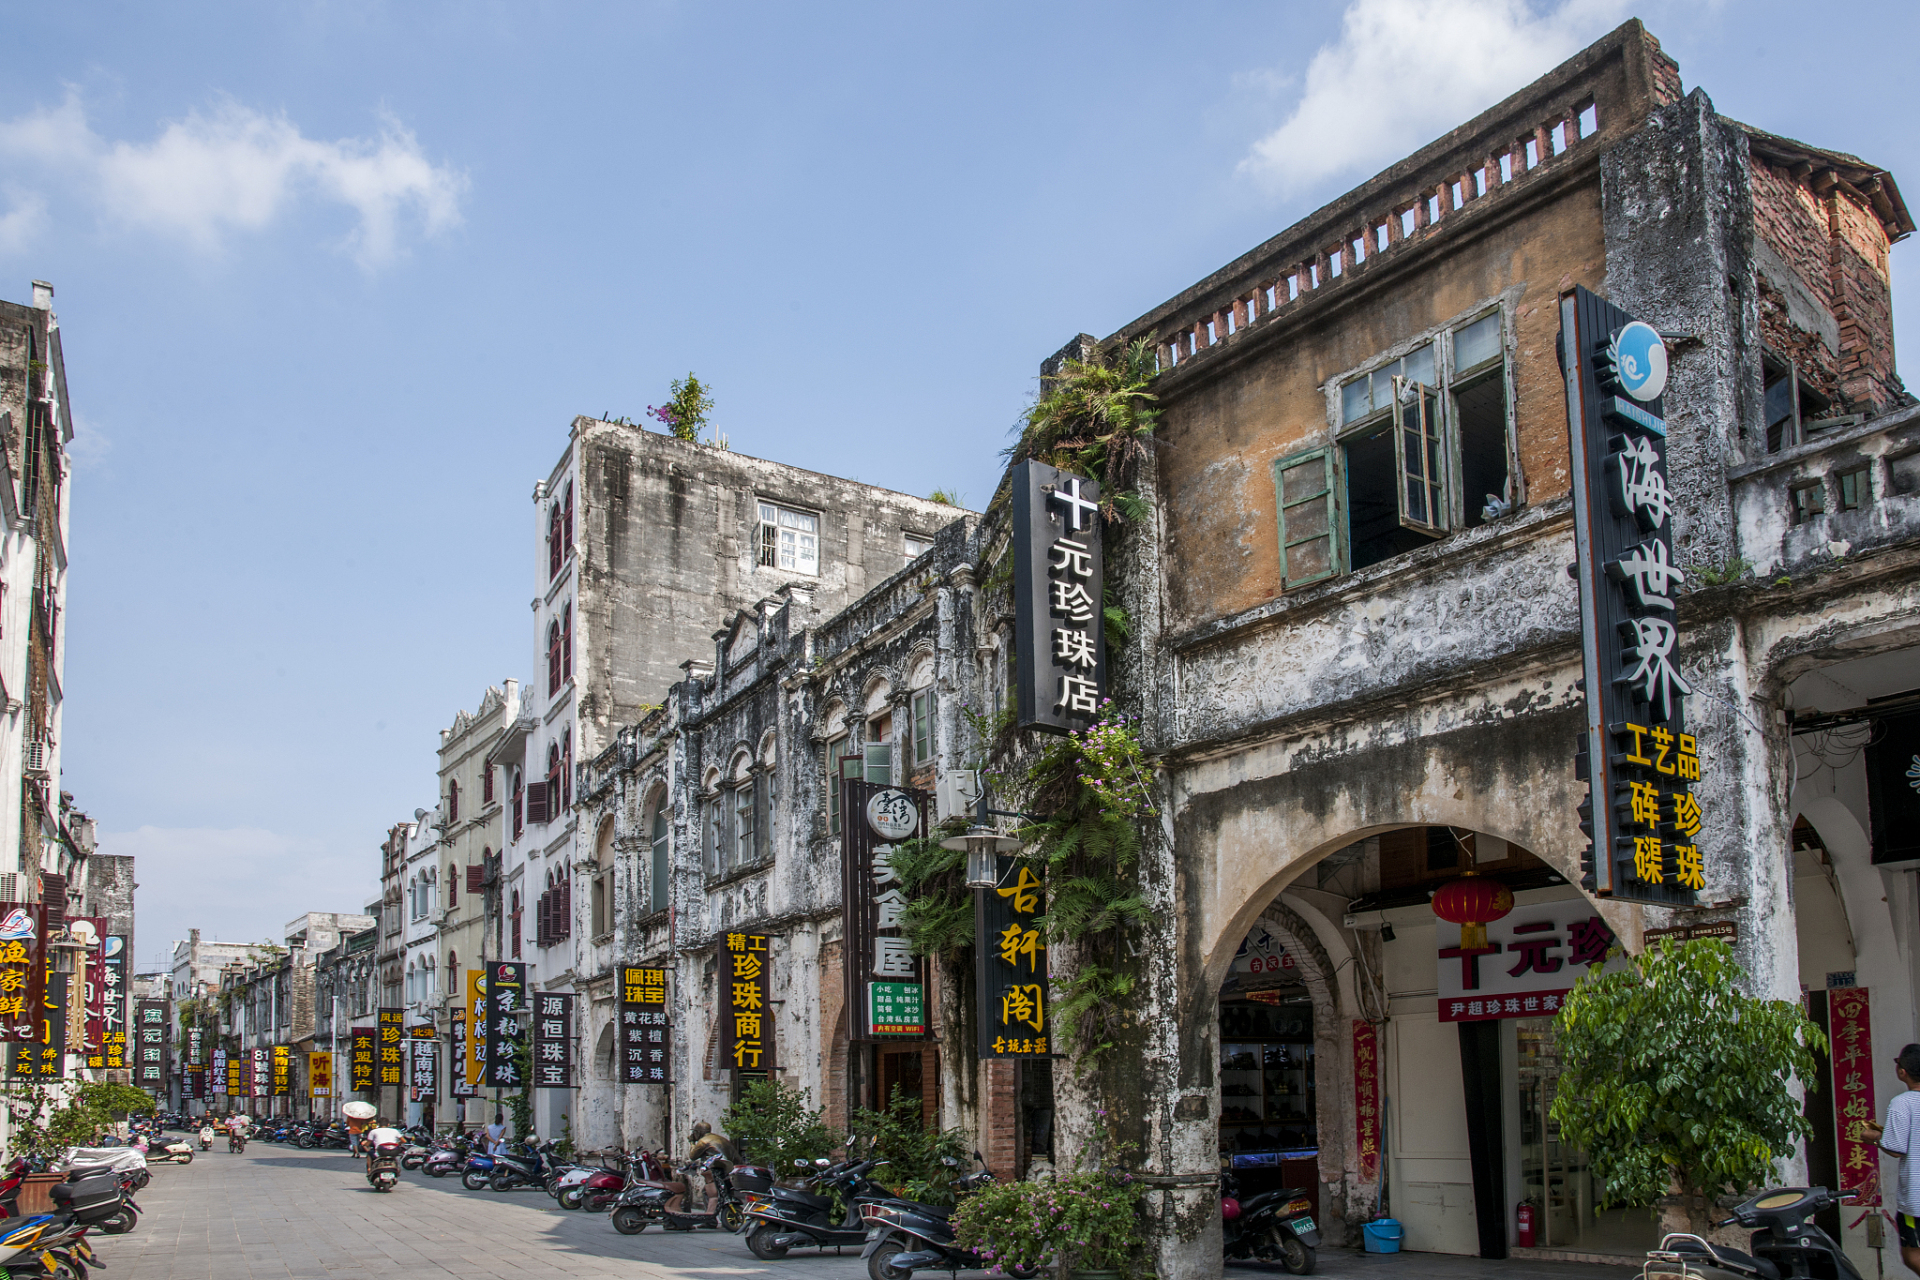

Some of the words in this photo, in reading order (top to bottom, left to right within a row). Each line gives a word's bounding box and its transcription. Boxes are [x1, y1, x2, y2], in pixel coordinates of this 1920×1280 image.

[1618, 400, 1666, 433] HAISHIJIE
[1053, 478, 1099, 714] 十元珍珠店
[1621, 433, 1691, 721] 海世界
[1626, 722, 1700, 781] 工艺品
[1629, 781, 1664, 884] 砗磲
[1673, 791, 1706, 890] 珍珠
[872, 843, 915, 977] 美食屋
[727, 932, 767, 951] 精工
[1439, 916, 1628, 990] 十元珍
[624, 1011, 666, 1026] 黄花梨
[625, 986, 664, 1003] 珠宝
[732, 952, 763, 1068] 珍珠商行
[107, 1044, 123, 1068] 珍珠
[213, 1049, 227, 1085] 越南红木
[353, 1036, 373, 1092] 东盟特产
[381, 1027, 401, 1083] 珍珠铺
[541, 996, 564, 1084] 源恒珠宝
[992, 1036, 1048, 1054] 古玩玉器
[274, 1046, 289, 1095] 东南亚特产
[312, 1056, 330, 1087] 听海
[413, 1041, 435, 1102] 越南特产
